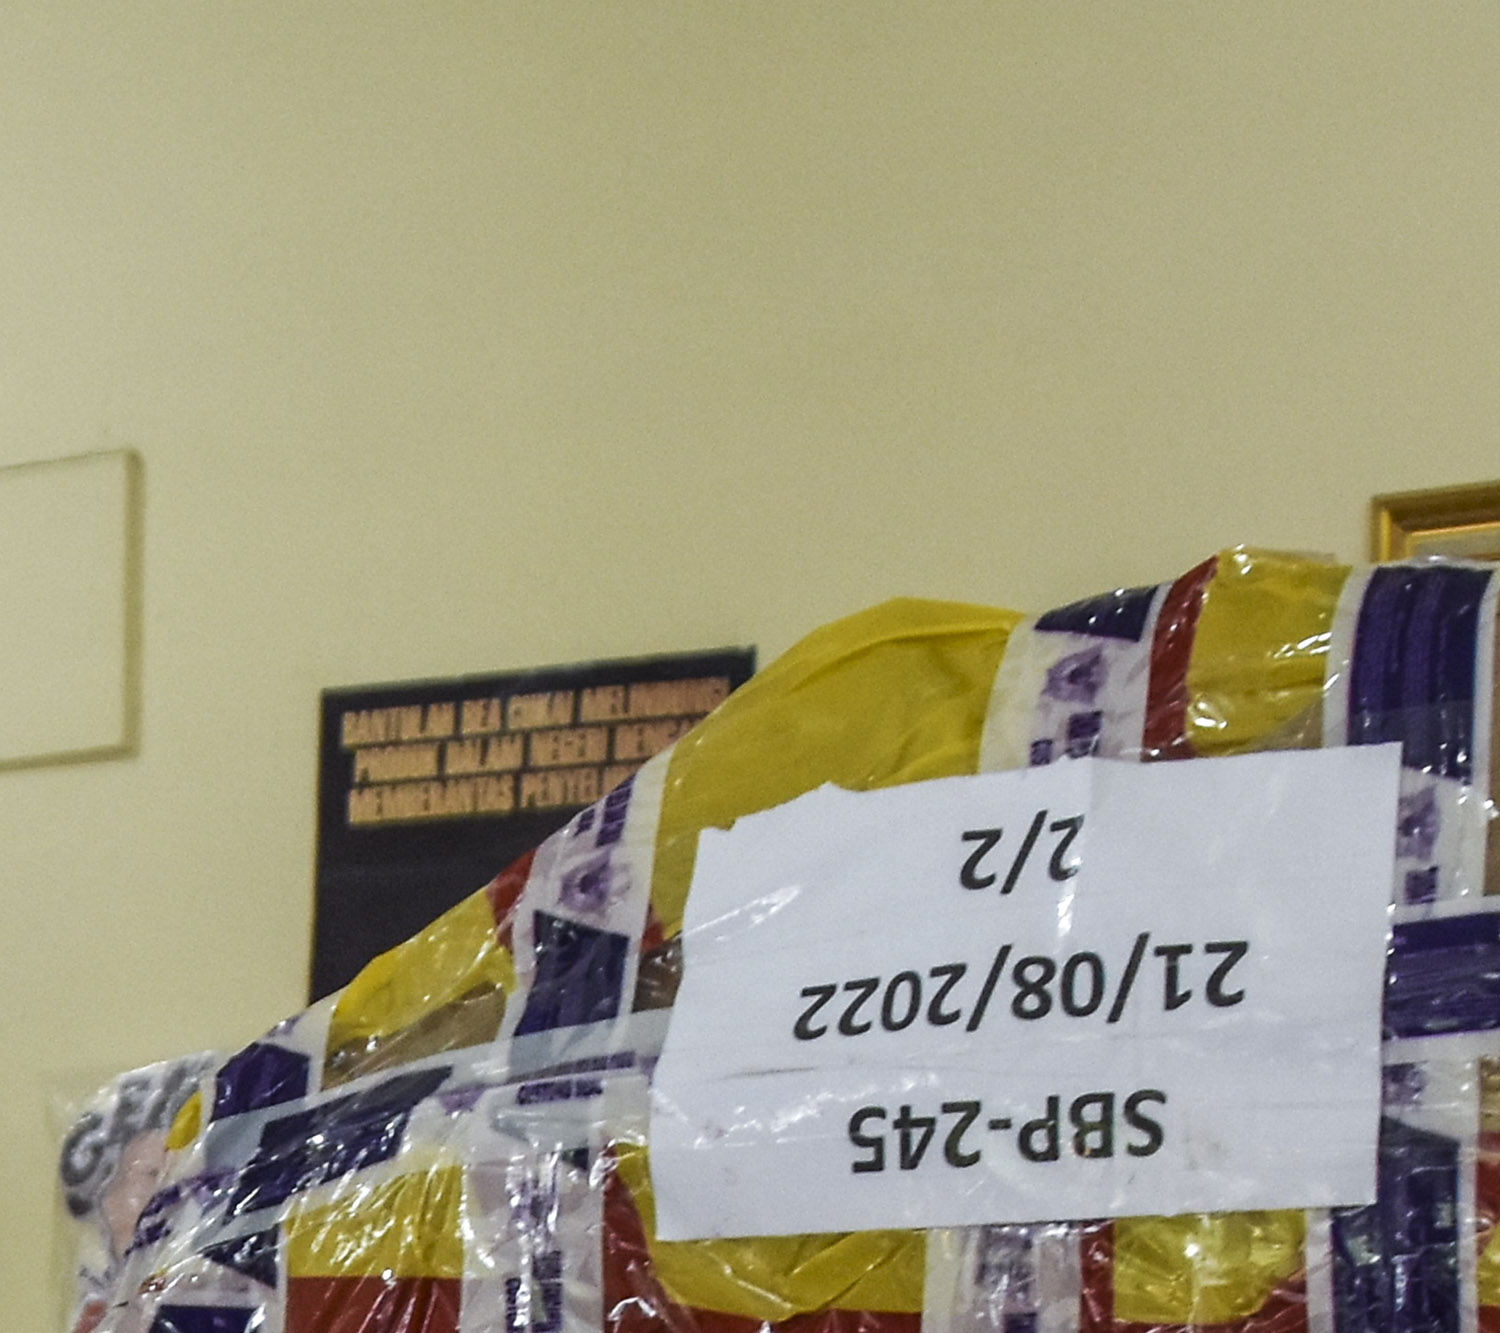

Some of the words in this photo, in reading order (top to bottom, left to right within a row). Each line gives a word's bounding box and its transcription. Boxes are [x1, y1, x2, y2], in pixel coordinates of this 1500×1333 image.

[342, 702, 456, 748] BANTULAH
[460, 697, 502, 738] BEA
[507, 689, 575, 731] CUKAI
[355, 739, 440, 783] PRODUK
[446, 732, 524, 774] DALAM
[530, 724, 609, 766] NEGERI
[349, 773, 517, 826] MEMBERANTAS
[959, 809, 1084, 894] 2/2
[793, 932, 1248, 1041] 21/08/2022
[848, 1089, 1168, 1173] SBP-245
